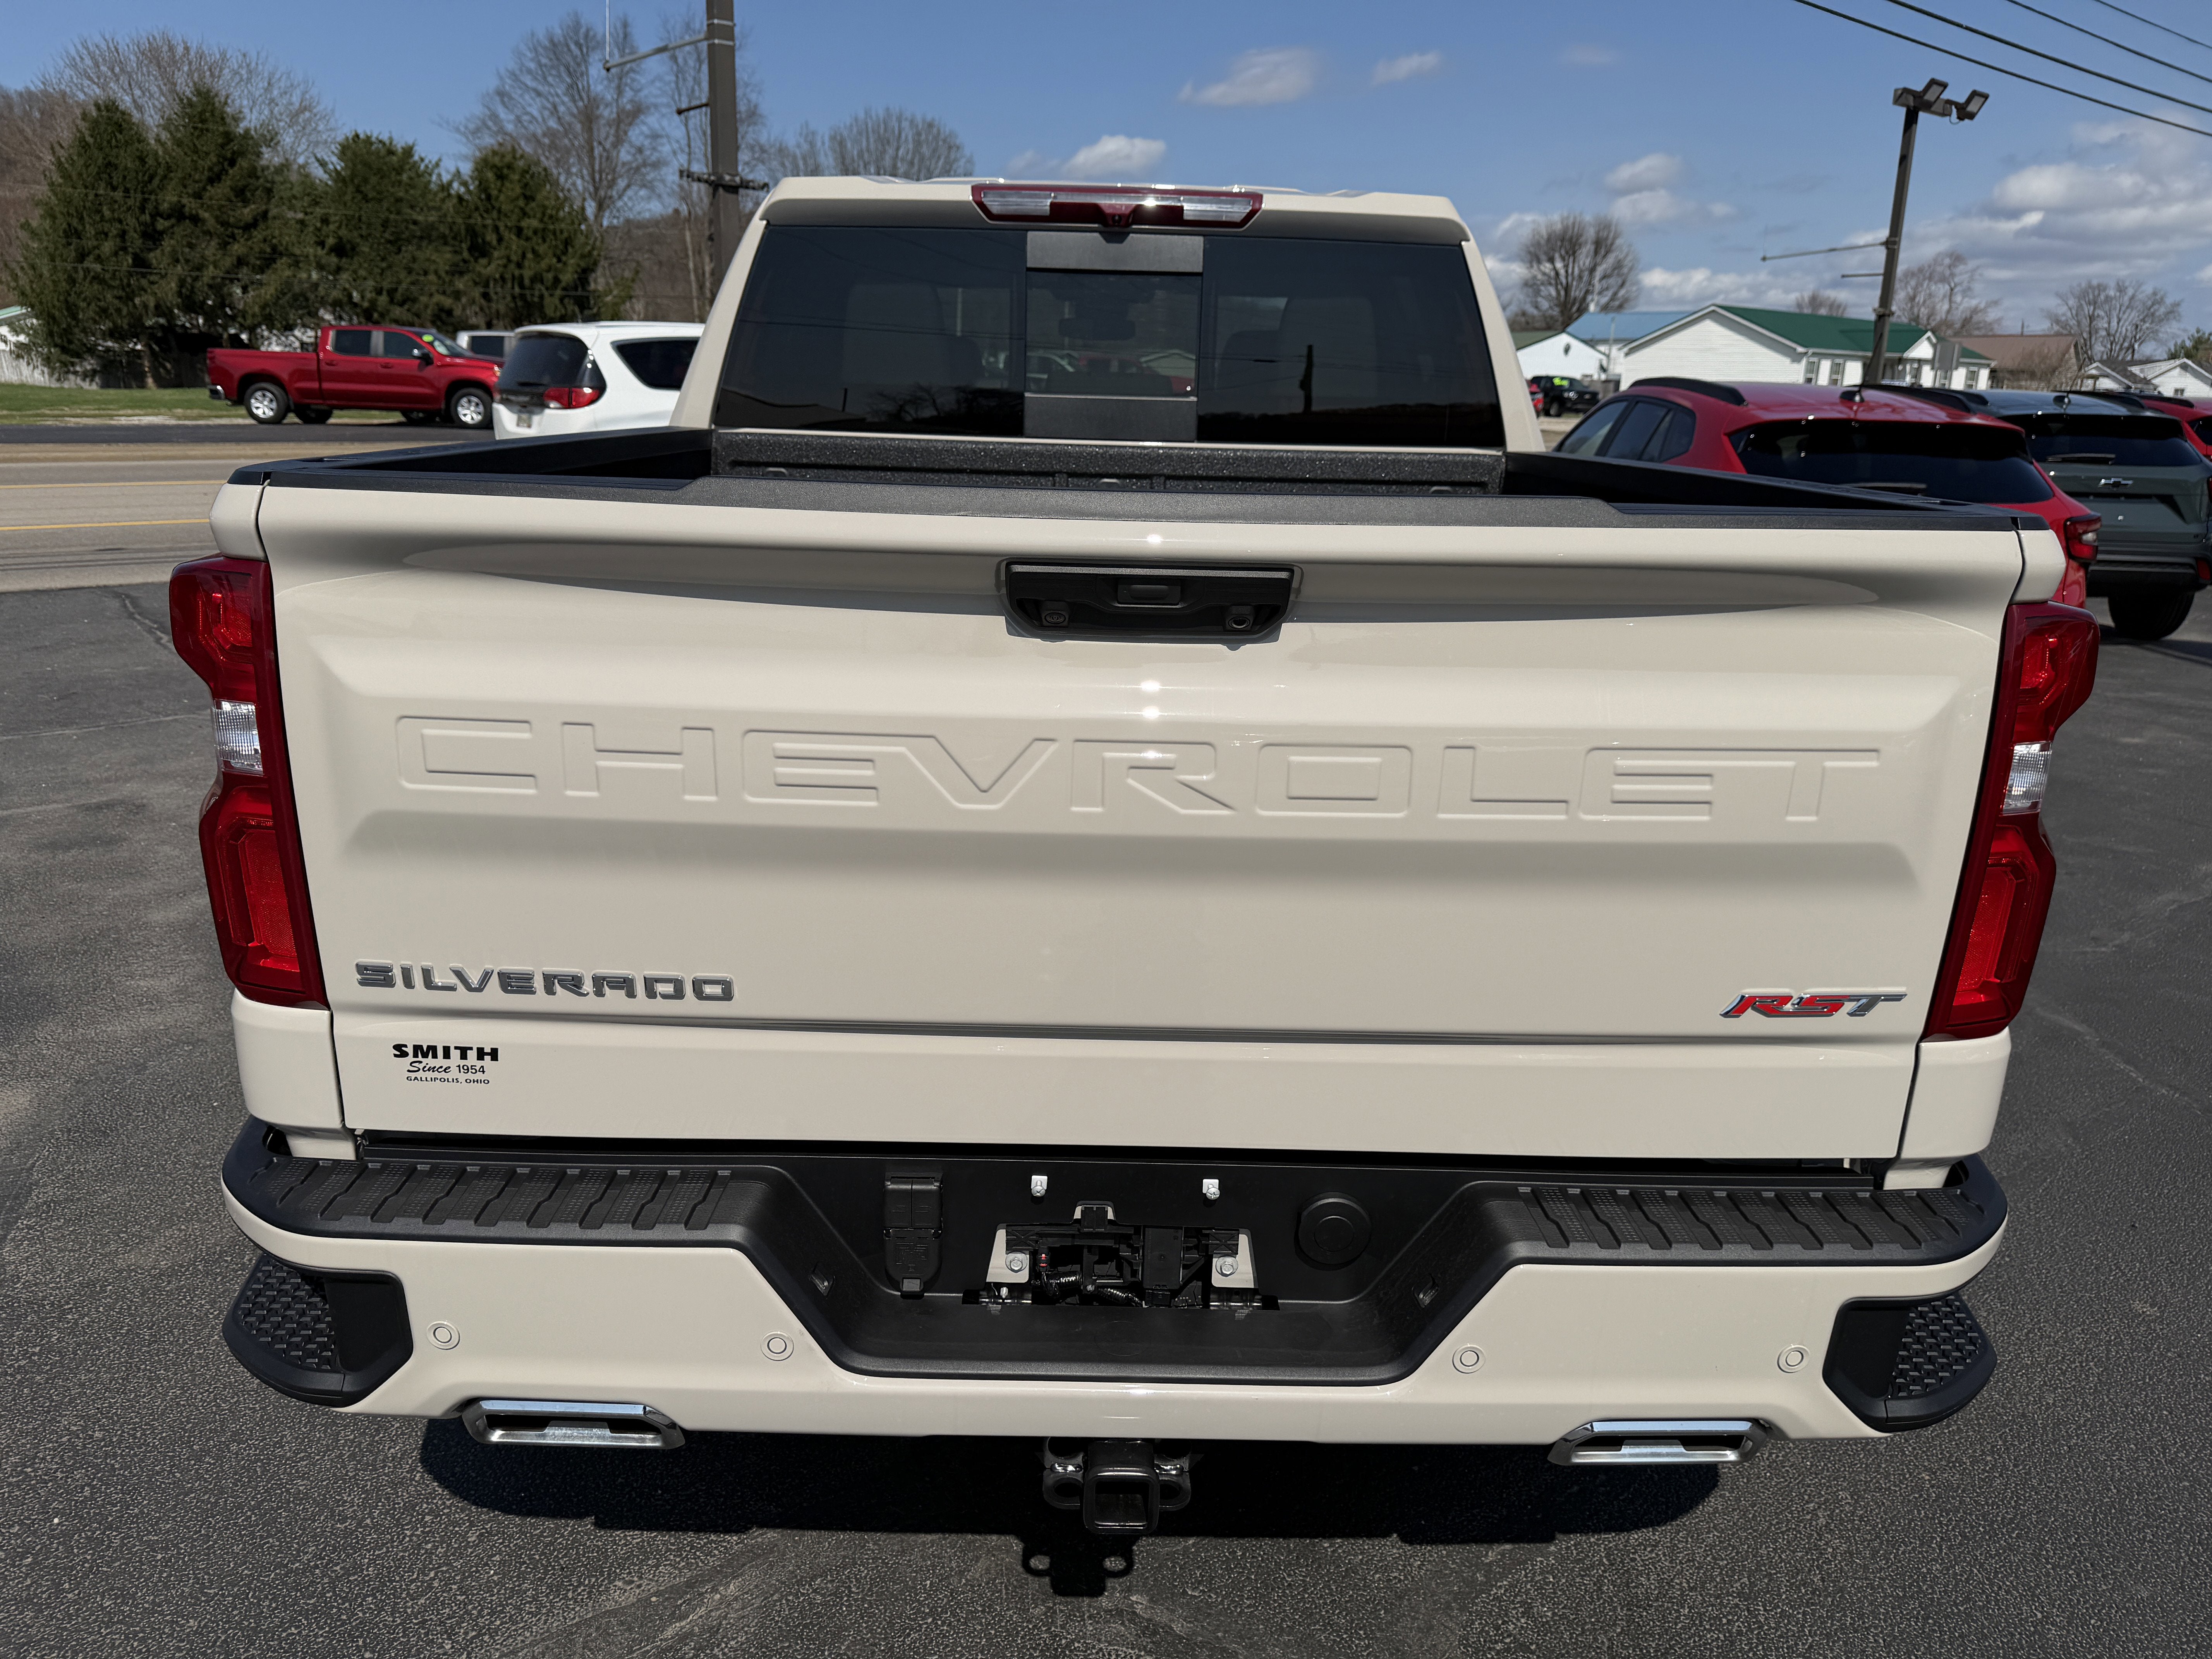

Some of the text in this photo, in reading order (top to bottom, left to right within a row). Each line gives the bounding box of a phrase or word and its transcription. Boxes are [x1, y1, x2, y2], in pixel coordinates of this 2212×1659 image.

[396, 716, 1881, 821] CHEVROLET
[355, 961, 735, 1001] SILVERADO
[1719, 992, 1908, 1018] RST
[392, 1043, 499, 1061] SMITH
[406, 1060, 486, 1075] Since 1954
[406, 1076, 462, 1084] GALLIPOLIS,
